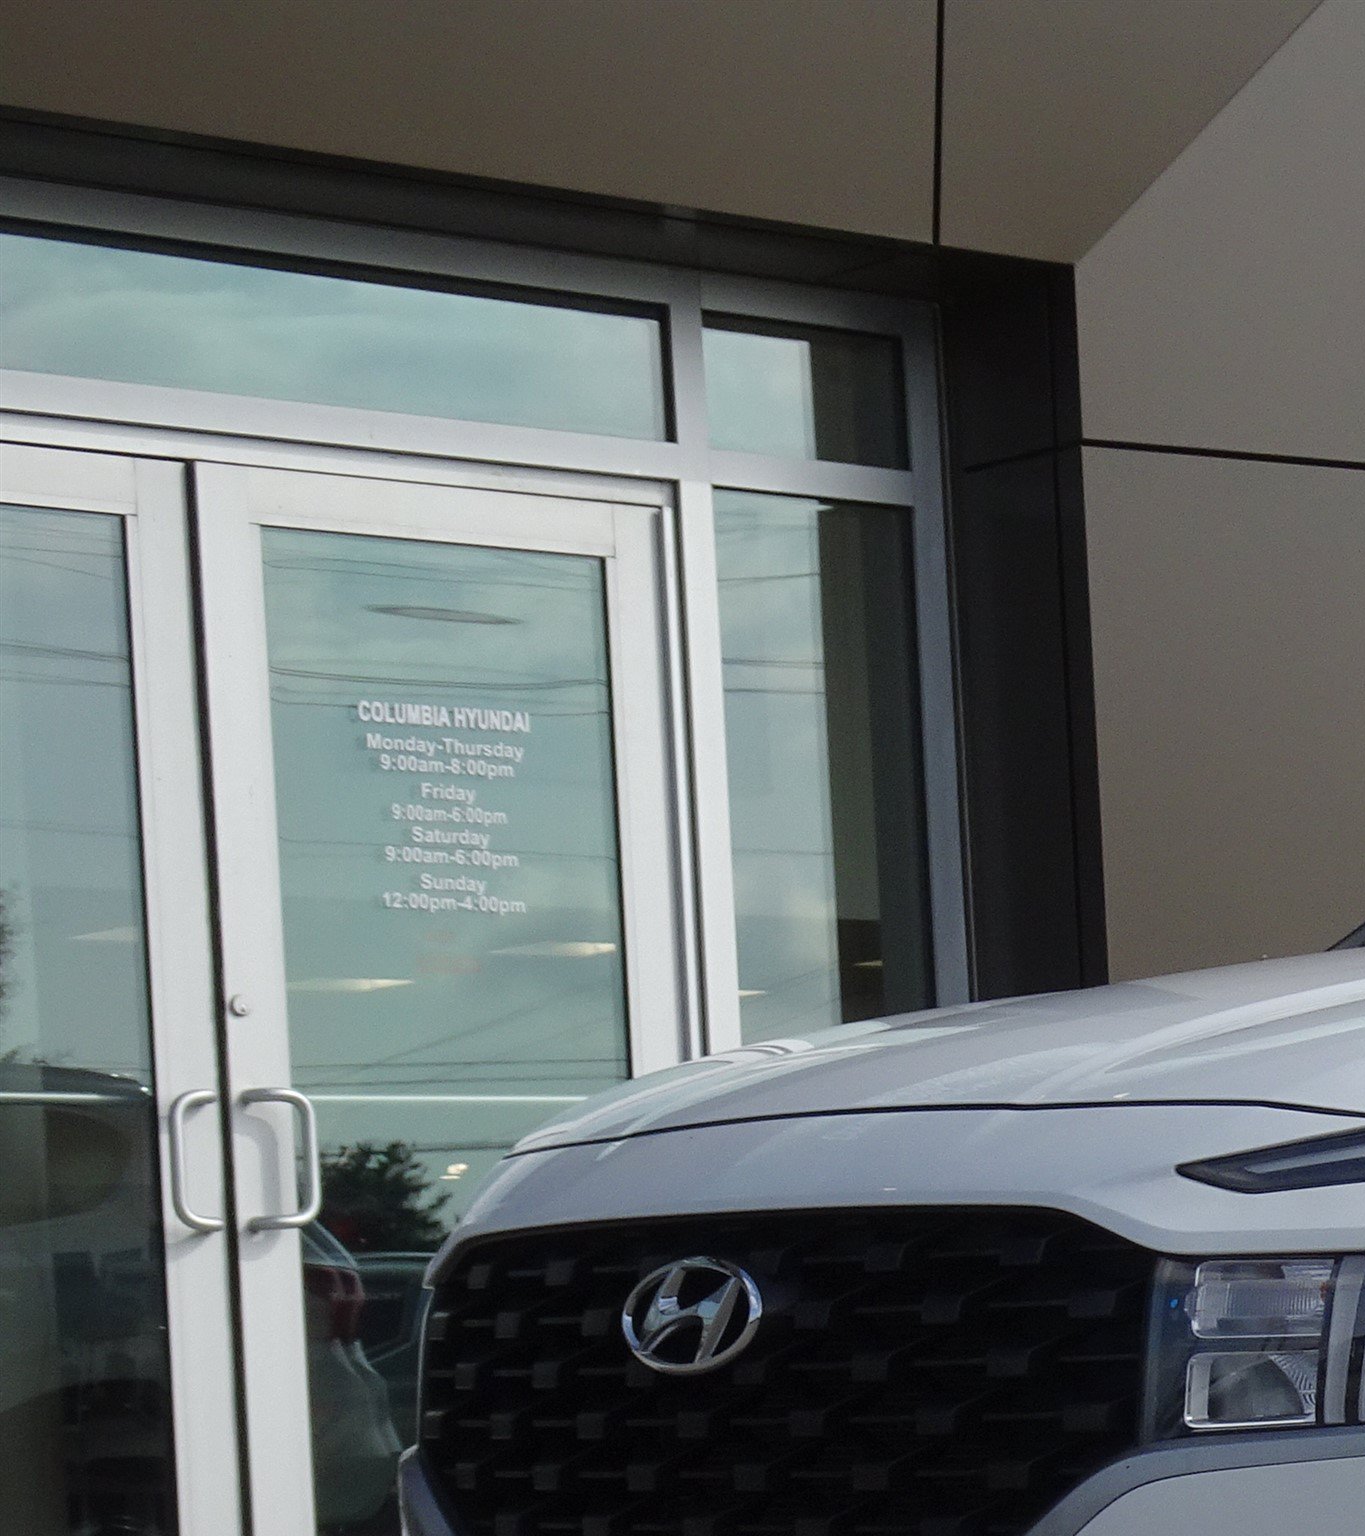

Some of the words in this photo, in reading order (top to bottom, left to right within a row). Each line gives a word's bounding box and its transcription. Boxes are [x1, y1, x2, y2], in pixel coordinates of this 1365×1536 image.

[357, 700, 451, 728] COLUMBIA
[454, 708, 530, 732] HYUNDAI
[366, 733, 524, 762] Monday-Thursday
[380, 754, 515, 779] 9:00am-8:00pm
[421, 782, 476, 804] Friday
[392, 803, 508, 827] 9:00am-6:00pm
[411, 826, 490, 849] Saturday
[385, 846, 519, 869] 9:00am-6:00pm
[420, 873, 487, 895] Sunday
[383, 891, 526, 915] 12:00pm-4:00pm
